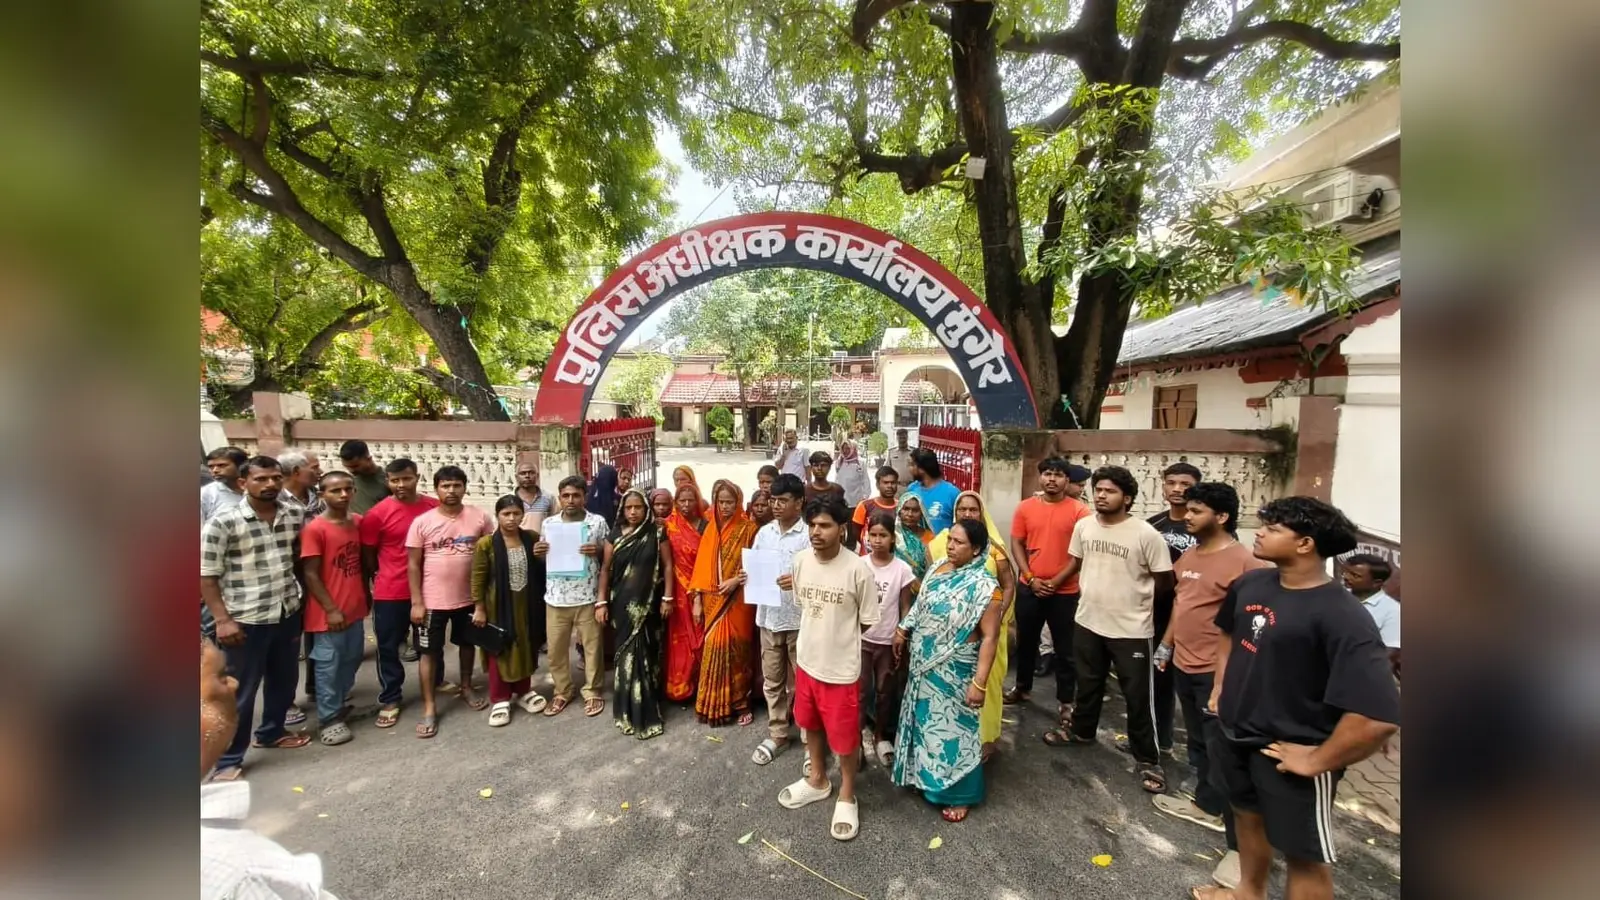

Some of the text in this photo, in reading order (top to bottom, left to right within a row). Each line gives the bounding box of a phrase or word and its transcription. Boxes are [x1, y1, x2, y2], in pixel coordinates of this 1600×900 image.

[555, 225, 1012, 388] पुलिस अधीक्षक कार्यालय मुंगेर
[1091, 539, 1130, 560] FRANCISCO
[798, 586, 813, 600] NE
[815, 588, 844, 604] PIECE
